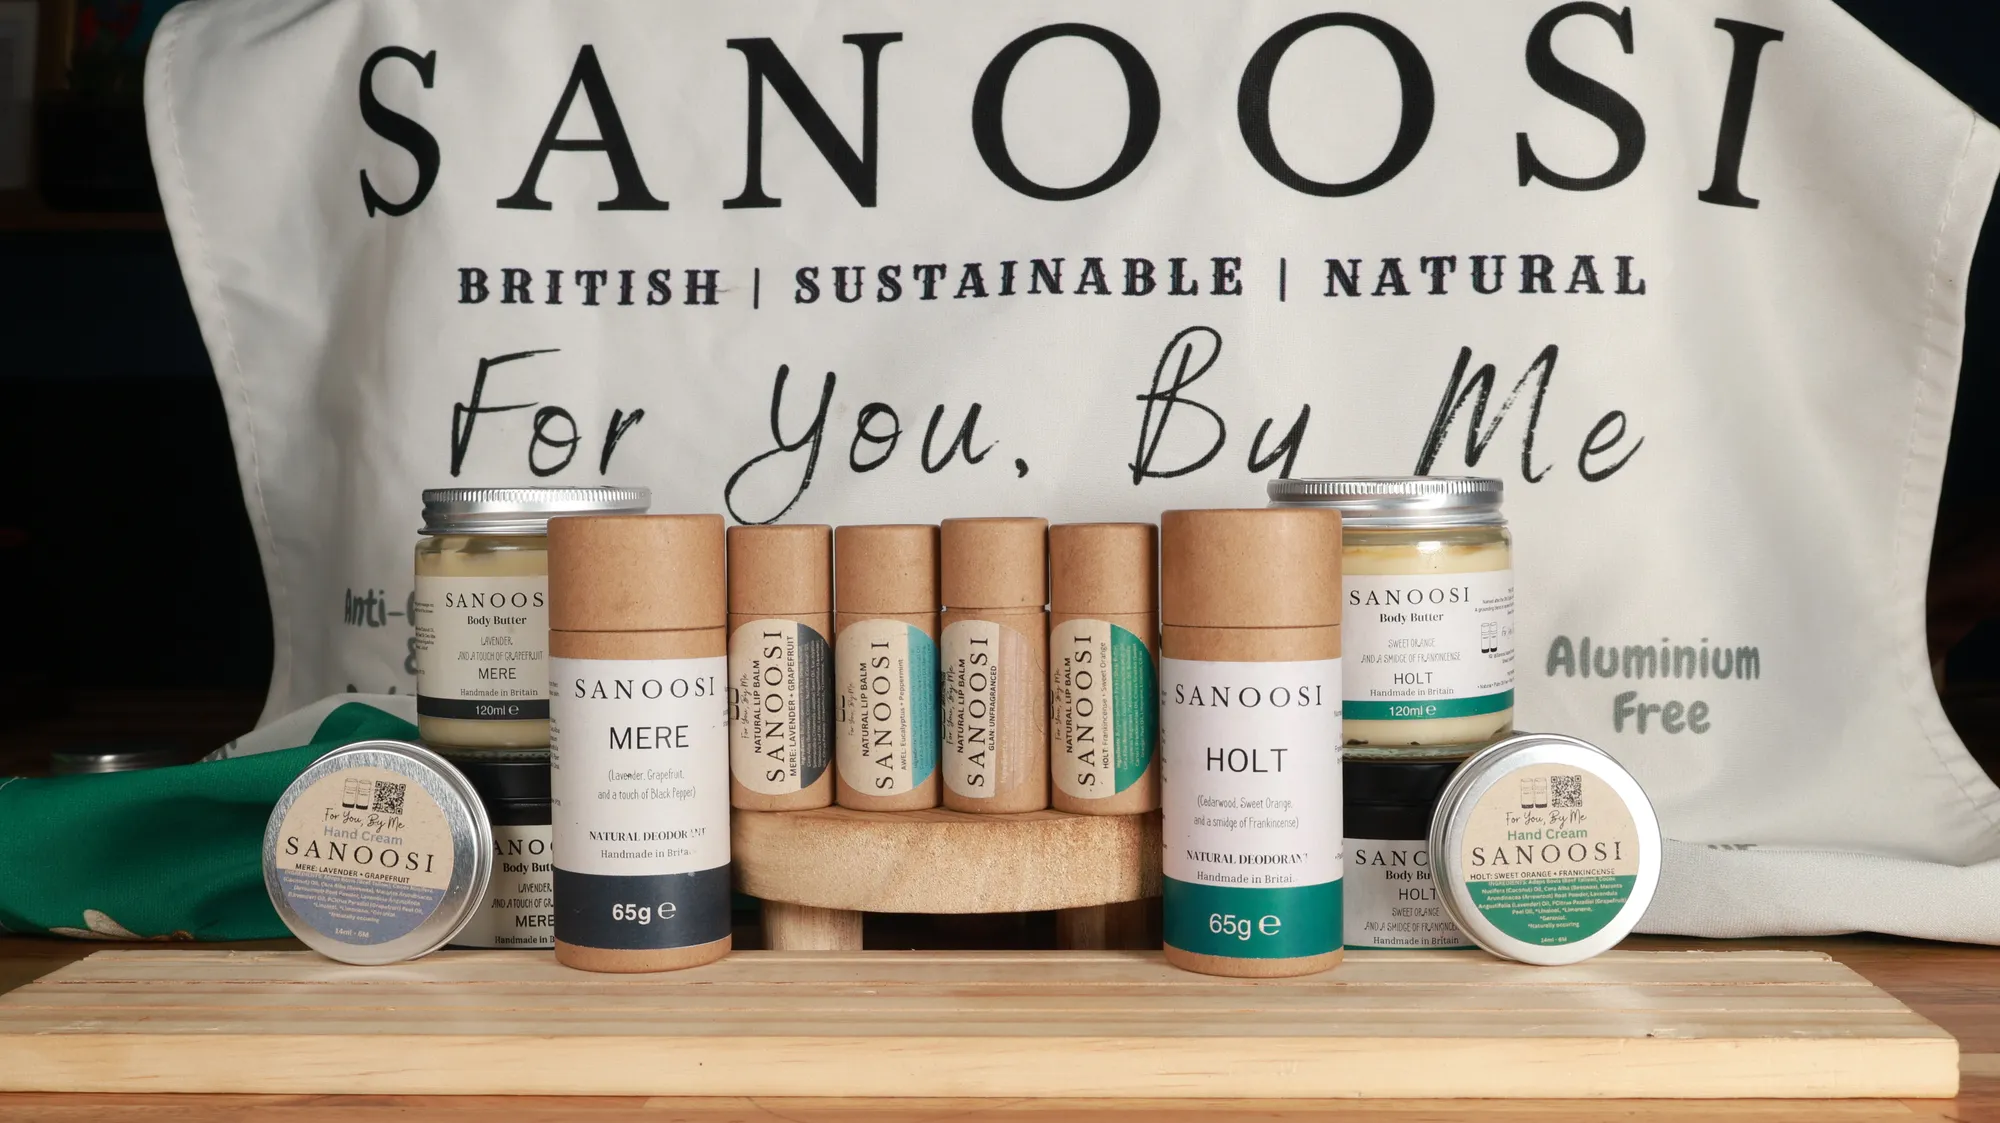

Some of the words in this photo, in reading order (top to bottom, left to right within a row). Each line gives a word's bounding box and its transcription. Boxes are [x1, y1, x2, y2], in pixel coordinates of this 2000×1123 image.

[358, 1, 1784, 218] SANOOSI
[458, 266, 721, 306] BRITISH
[794, 256, 1243, 305] SUSTAINABLE
[1324, 254, 1647, 297] NATURAL
[451, 348, 645, 478] For
[724, 363, 1029, 526] You,
[1127, 325, 1311, 486] By
[1412, 343, 1646, 485] Me
[445, 592, 545, 609] SANOOS
[1349, 586, 1471, 606] SANOOSI
[467, 615, 491, 628] Body
[493, 615, 528, 626] Butter
[1379, 613, 1408, 625] Body
[1410, 611, 1445, 623] Butter
[1388, 638, 1410, 649] SWEET
[1410, 637, 1436, 648] ORANGE
[786, 636, 796, 691] GRAPEFRUIT
[1098, 641, 1107, 669] Orange
[1408, 652, 1417, 662] OF
[1545, 634, 1761, 681] Aluminium
[478, 667, 517, 680] MERE
[752, 659, 761, 689] BALM
[859, 662, 868, 690] BALM
[897, 659, 906, 701] Peppermint
[958, 659, 966, 688] BALM
[1064, 657, 1072, 686] BALM
[1099, 669, 1107, 692] Sweet
[1394, 672, 1433, 685] HOLT
[460, 688, 499, 697] Handmade
[500, 688, 509, 697] in
[510, 688, 539, 697] Britain
[574, 676, 715, 700] SANOOSI
[753, 689, 761, 706] LIP
[957, 689, 965, 705] LIP
[989, 665, 997, 727] UNFRAGRANCED
[1064, 688, 1073, 704] LIP
[1175, 683, 1323, 708] SANOOSI
[1370, 688, 1416, 697] Handmade
[1417, 688, 1426, 696] in
[1427, 687, 1455, 696] Britain
[475, 705, 506, 716] 120ml
[763, 630, 786, 783] SANOOSI
[860, 693, 869, 709] LIP
[967, 637, 989, 788] SANOOSI
[1074, 635, 1096, 787] SANOOSI
[1389, 705, 1424, 717] 120ml
[1613, 690, 1712, 735] Free
[788, 700, 797, 747] LAVENDER
[871, 641, 894, 790] SANOOSI
[1100, 698, 1109, 746] Frankincense
[609, 725, 690, 750] MERE
[754, 707, 762, 754] NATURAL
[861, 710, 870, 757] NATURAL
[899, 708, 908, 747] Eucalyptus
[957, 707, 965, 753] NATURAL
[1065, 706, 1073, 753] NATURAL
[988, 728, 996, 751] GLAN:
[789, 749, 797, 777] MERE:
[1207, 747, 1289, 773] HOLT
[597, 789, 611, 800] and
[612, 790, 617, 800] a
[619, 788, 640, 800] touch
[641, 788, 650, 800] of
[650, 788, 671, 800] Black
[672, 786, 697, 801] Pepper)
[1240, 796, 1264, 809] Sweet
[324, 807, 340, 823] For
[367, 812, 387, 834] By
[387, 816, 406, 830] Me
[1193, 815, 1205, 826] and
[1206, 817, 1211, 827] a
[1212, 816, 1238, 831] smidge
[1239, 817, 1248, 829] of
[1249, 816, 1299, 830] Frankincense)
[1505, 812, 1521, 826] For
[1549, 810, 1568, 829] By
[1569, 809, 1587, 824] Me
[324, 825, 358, 841] Hand
[362, 830, 404, 846] Cream
[589, 830, 641, 843] NATURAL
[1507, 829, 1542, 841] Hand
[1545, 827, 1588, 840] Cream
[285, 836, 436, 874] SANOOSI
[601, 849, 653, 859] Handmade
[655, 849, 665, 858] in
[1186, 850, 1237, 864] NATURAL
[1355, 849, 1428, 867] SANO
[1471, 841, 1622, 867] SANOOSI
[295, 863, 318, 874] MERE:
[319, 866, 359, 878] LAVENDER
[364, 871, 411, 884] GRAPEFRUIT
[503, 862, 529, 875] Body
[1197, 871, 1249, 883] Handmade
[1251, 874, 1262, 884] in
[1385, 870, 1413, 883] Body
[1470, 872, 1493, 881] HOLT:
[1494, 871, 1519, 880] SWEET
[1520, 870, 1552, 879] ORANGE
[1558, 868, 1616, 877] FRANKINCENSE
[1398, 888, 1437, 901] HOLT
[612, 902, 652, 925] 65g
[1391, 907, 1413, 917] SWEET
[1209, 913, 1252, 940] 65g
[495, 935, 537, 944] Handmade
[539, 935, 547, 944] in
[1373, 936, 1419, 945] Handmade
[1421, 937, 1430, 945] in
[1431, 936, 1460, 945] Britain
